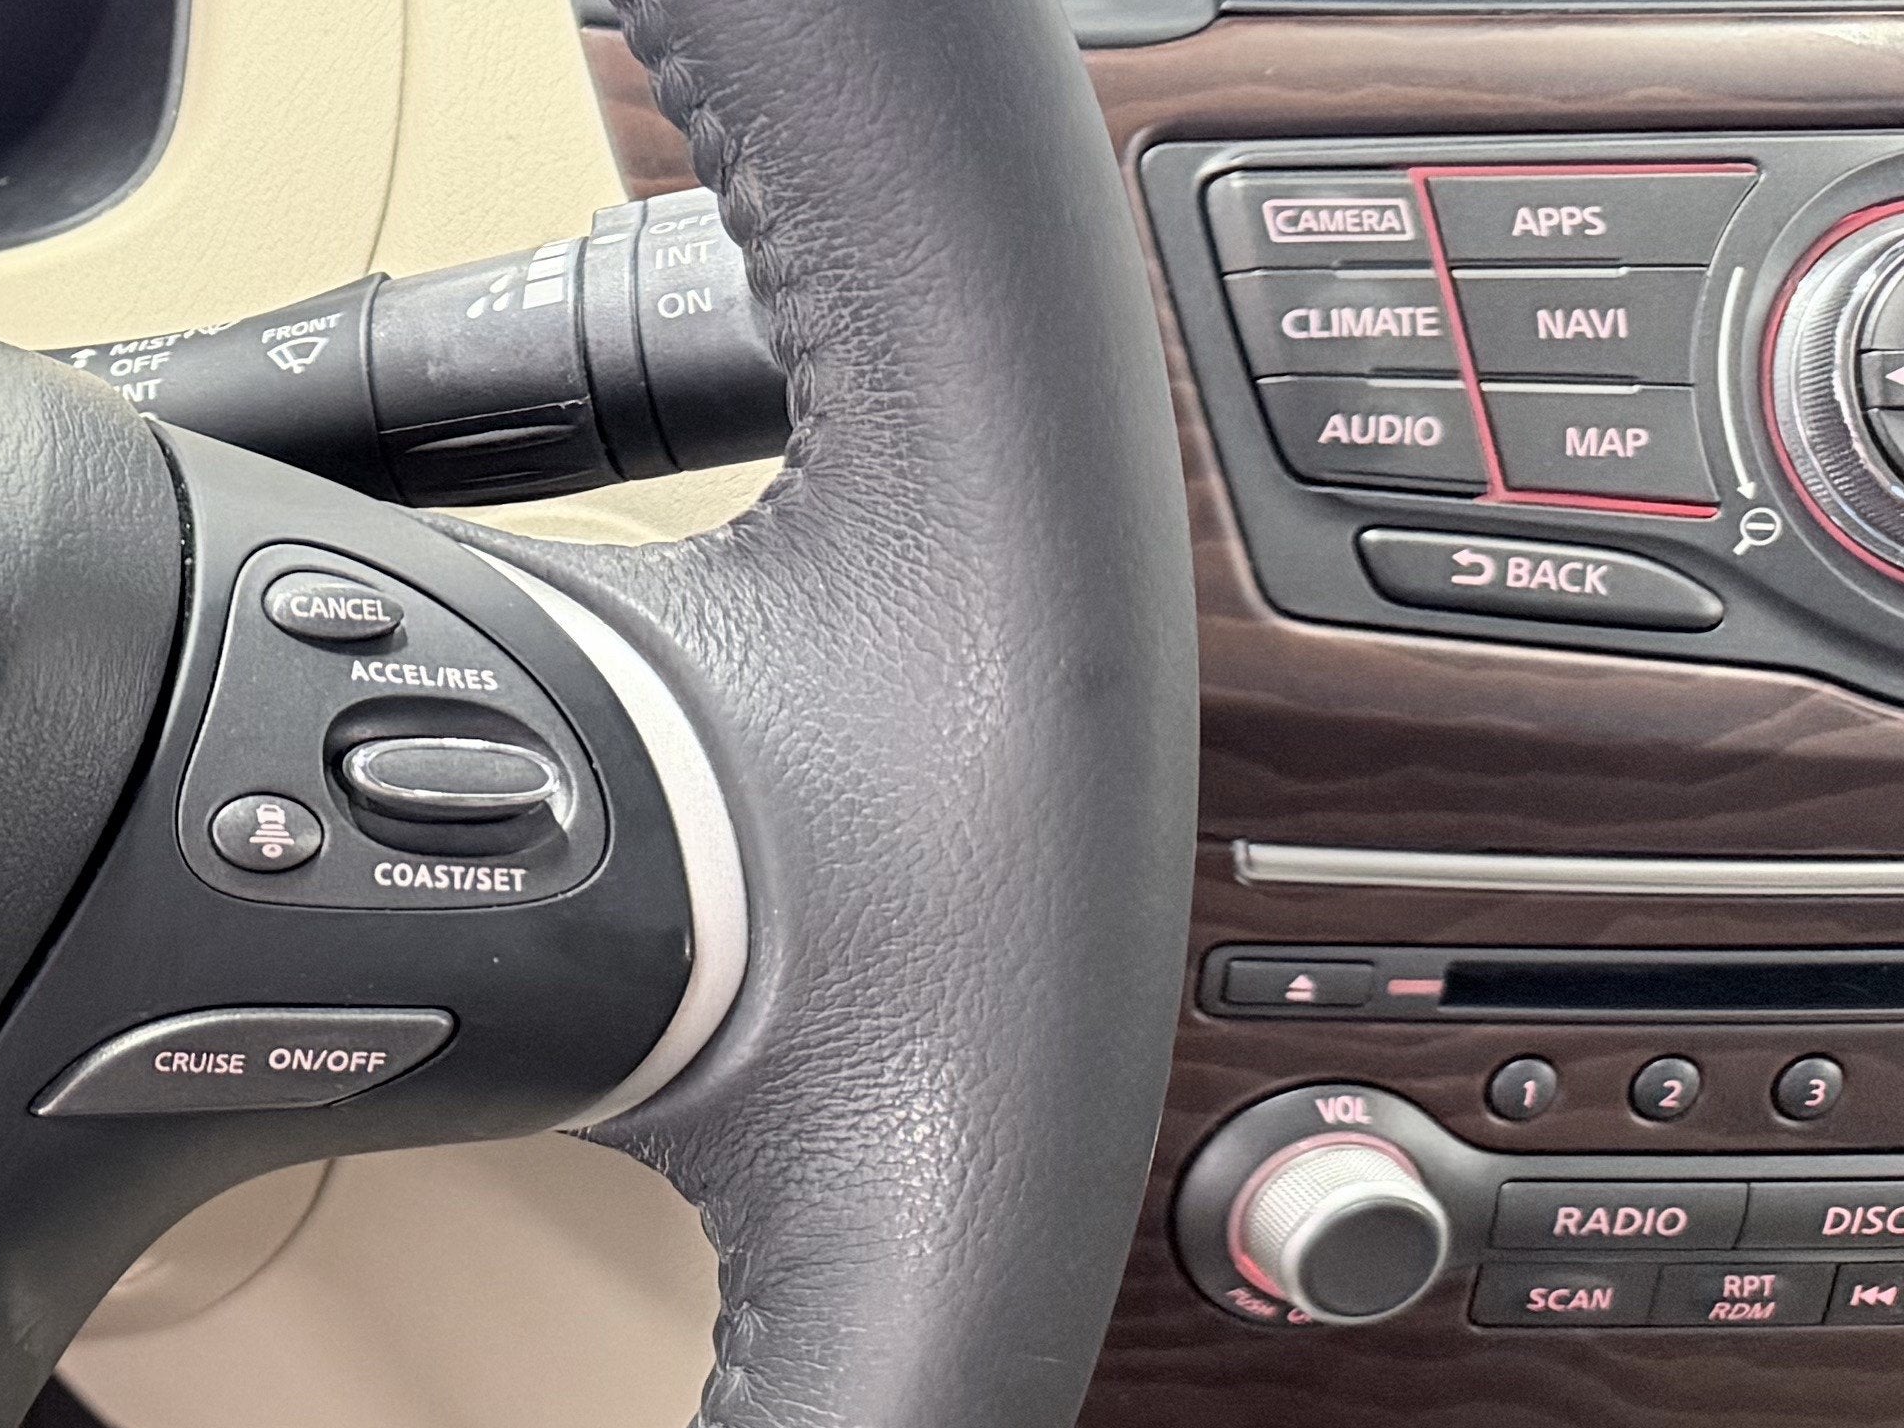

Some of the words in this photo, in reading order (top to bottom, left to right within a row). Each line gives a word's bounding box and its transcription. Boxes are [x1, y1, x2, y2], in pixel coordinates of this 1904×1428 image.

[649, 213, 721, 235] OFF
[1275, 208, 1404, 235] CAMERA
[1511, 206, 1608, 237] APPS
[655, 239, 720, 270] INT
[657, 287, 713, 319] ON
[261, 311, 354, 345] FRONT
[1281, 307, 1442, 338] CLIMATE
[1537, 308, 1628, 339] NAVI
[109, 333, 183, 356] MIST
[109, 350, 173, 377] OFF
[1318, 414, 1443, 447] AUDIO
[1565, 426, 1649, 459] MAP
[1505, 558, 1609, 596] BACK
[289, 593, 393, 625] CANCEL
[349, 658, 500, 692] ACCEL/RES
[372, 862, 527, 894] COAST/SET
[153, 1050, 247, 1076] CRUISE
[267, 1047, 389, 1075] ON/OFF
[1522, 1080, 1538, 1108] 1
[1658, 1080, 1682, 1108] 2
[1804, 1079, 1827, 1107] 3
[1315, 1096, 1373, 1126] VOL
[1553, 1207, 1689, 1238] RADIO
[1821, 1206, 1904, 1236] DISC
[1526, 1287, 1615, 1315] SCAN
[1723, 1274, 1777, 1299] RPT
[1708, 1301, 1777, 1321] RDM
